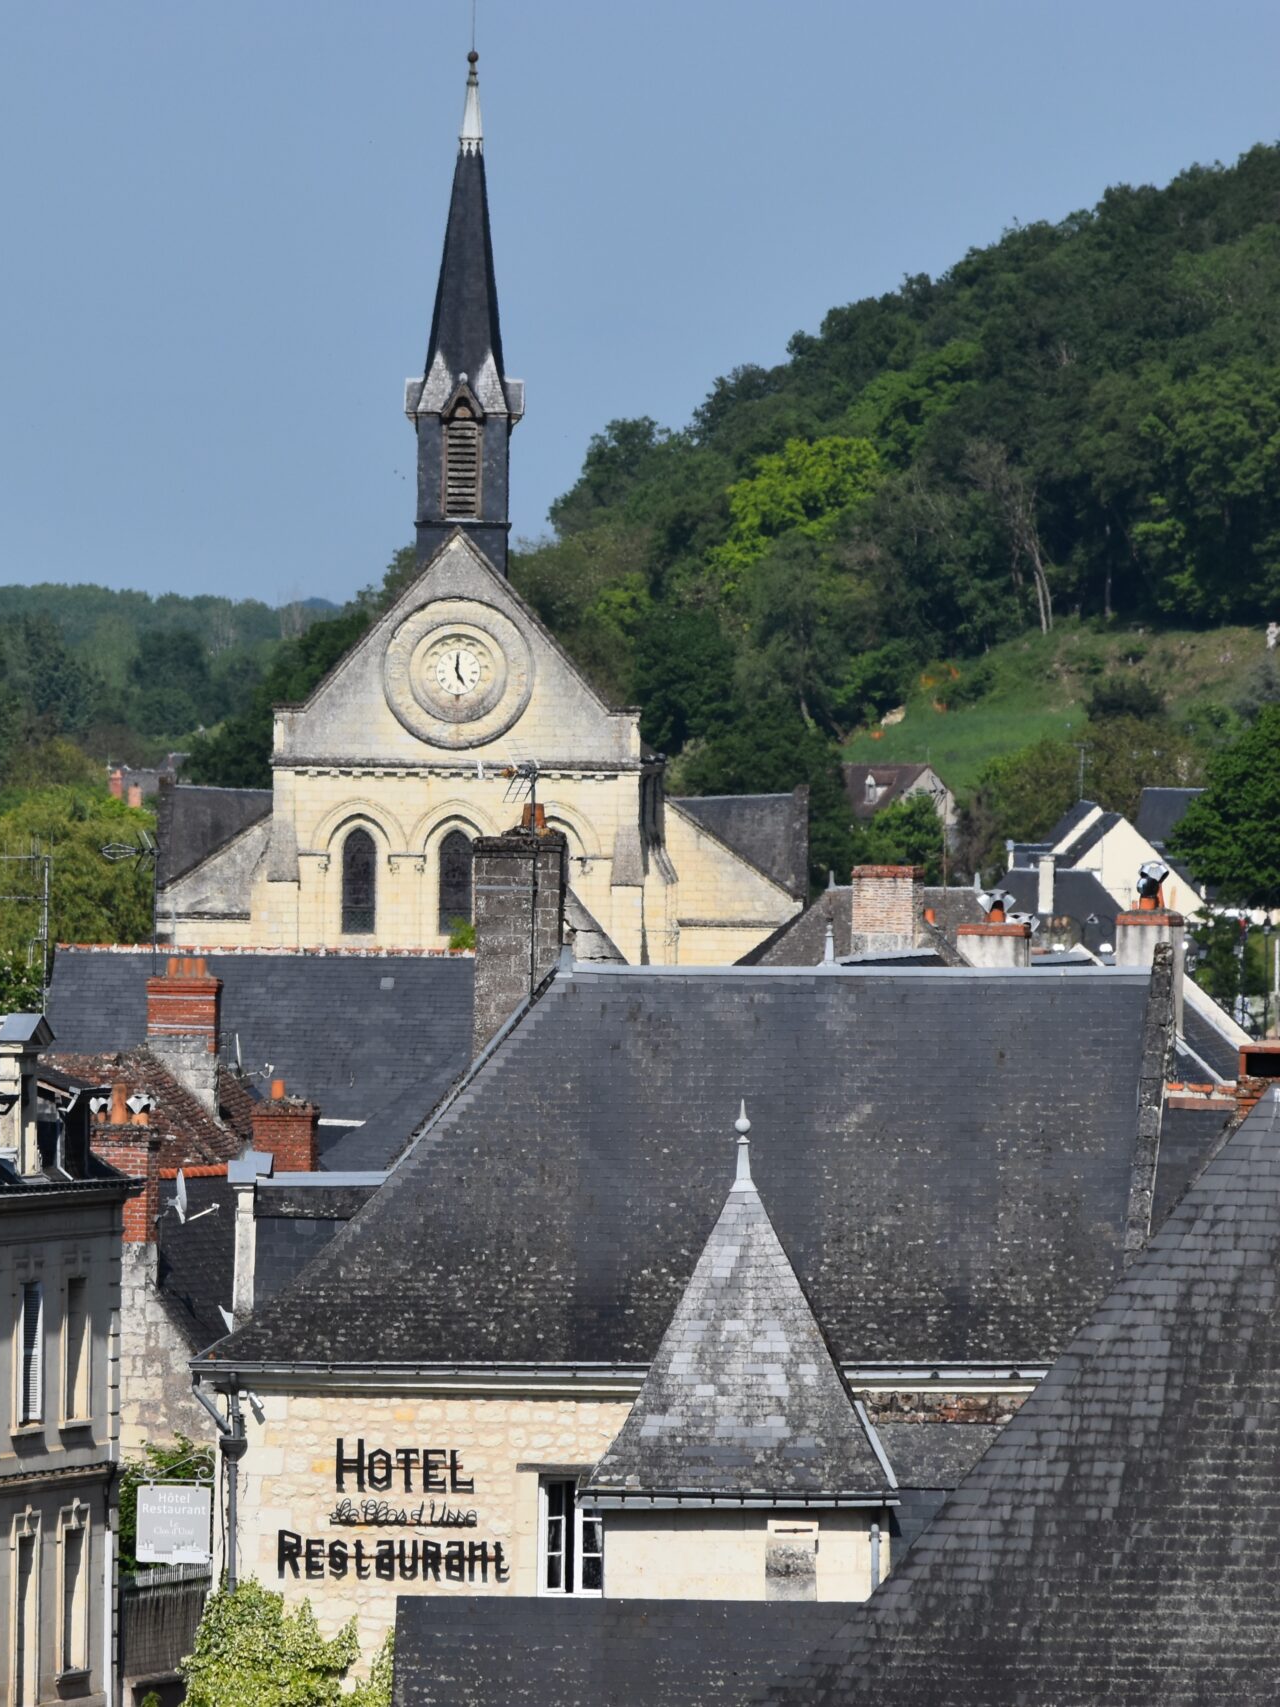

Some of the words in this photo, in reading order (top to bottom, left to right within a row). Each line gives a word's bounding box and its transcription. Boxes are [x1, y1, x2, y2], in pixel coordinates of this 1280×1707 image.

[335, 1437, 474, 1491] HOTEL
[158, 1492, 191, 1504] Hôtel
[142, 1503, 206, 1515] Restaurant
